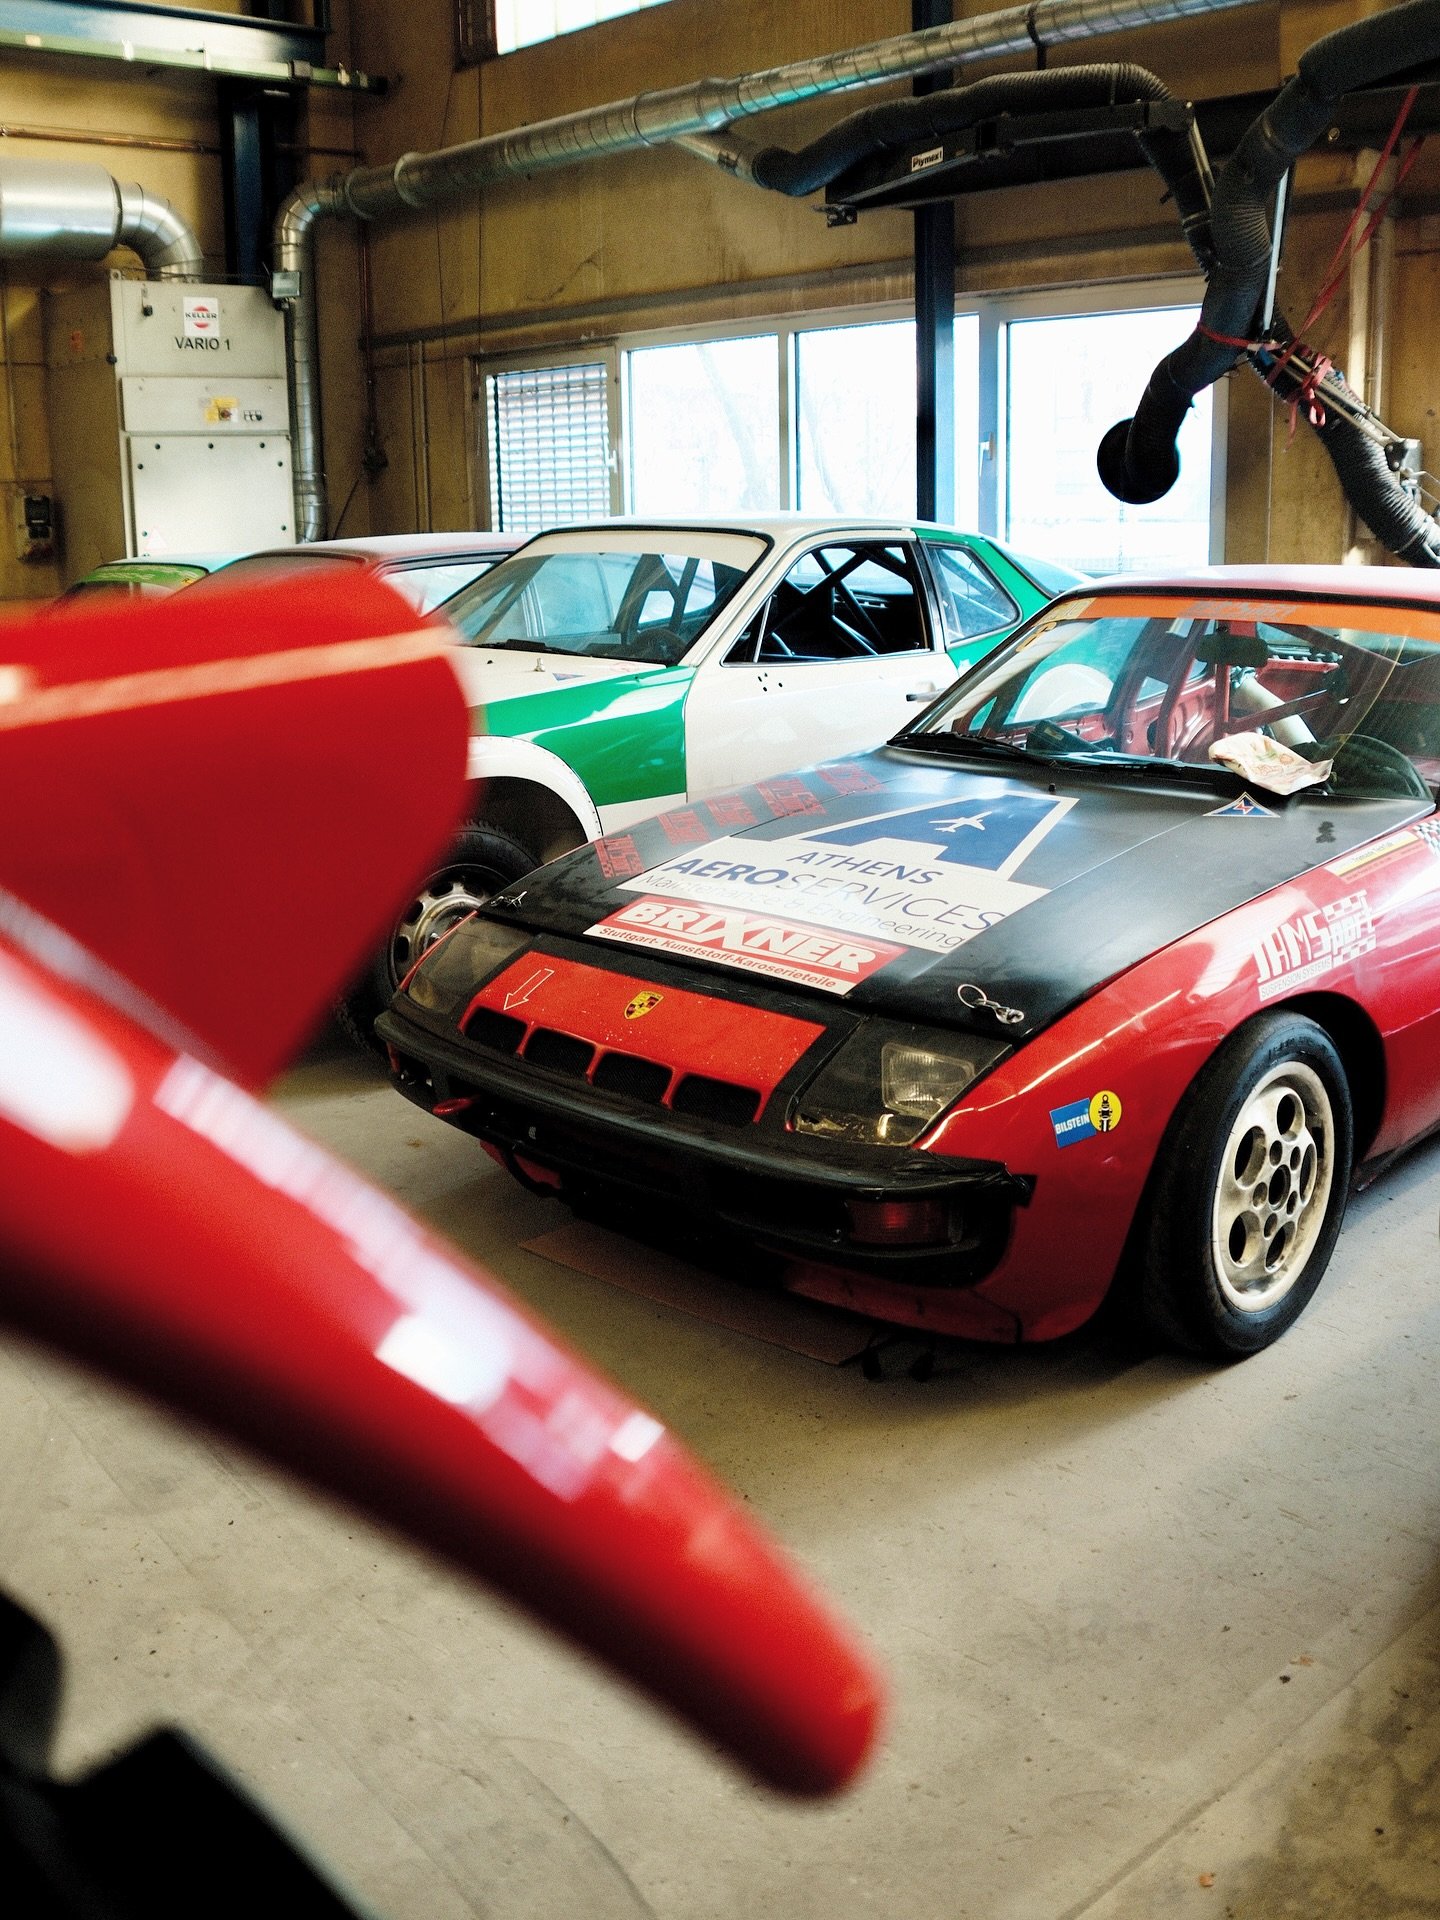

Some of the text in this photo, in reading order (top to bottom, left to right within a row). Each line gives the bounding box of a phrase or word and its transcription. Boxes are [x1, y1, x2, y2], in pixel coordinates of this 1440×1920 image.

[175, 336, 231, 350] VARIO 1
[786, 852, 943, 884] ATHENS
[661, 858, 1006, 930] AEROSERVICES
[617, 902, 876, 973] BRIXNER
[811, 902, 966, 948] Engineering
[1261, 972, 1301, 999] SUSPENSION
[1054, 1113, 1090, 1135] BILSTEIN
